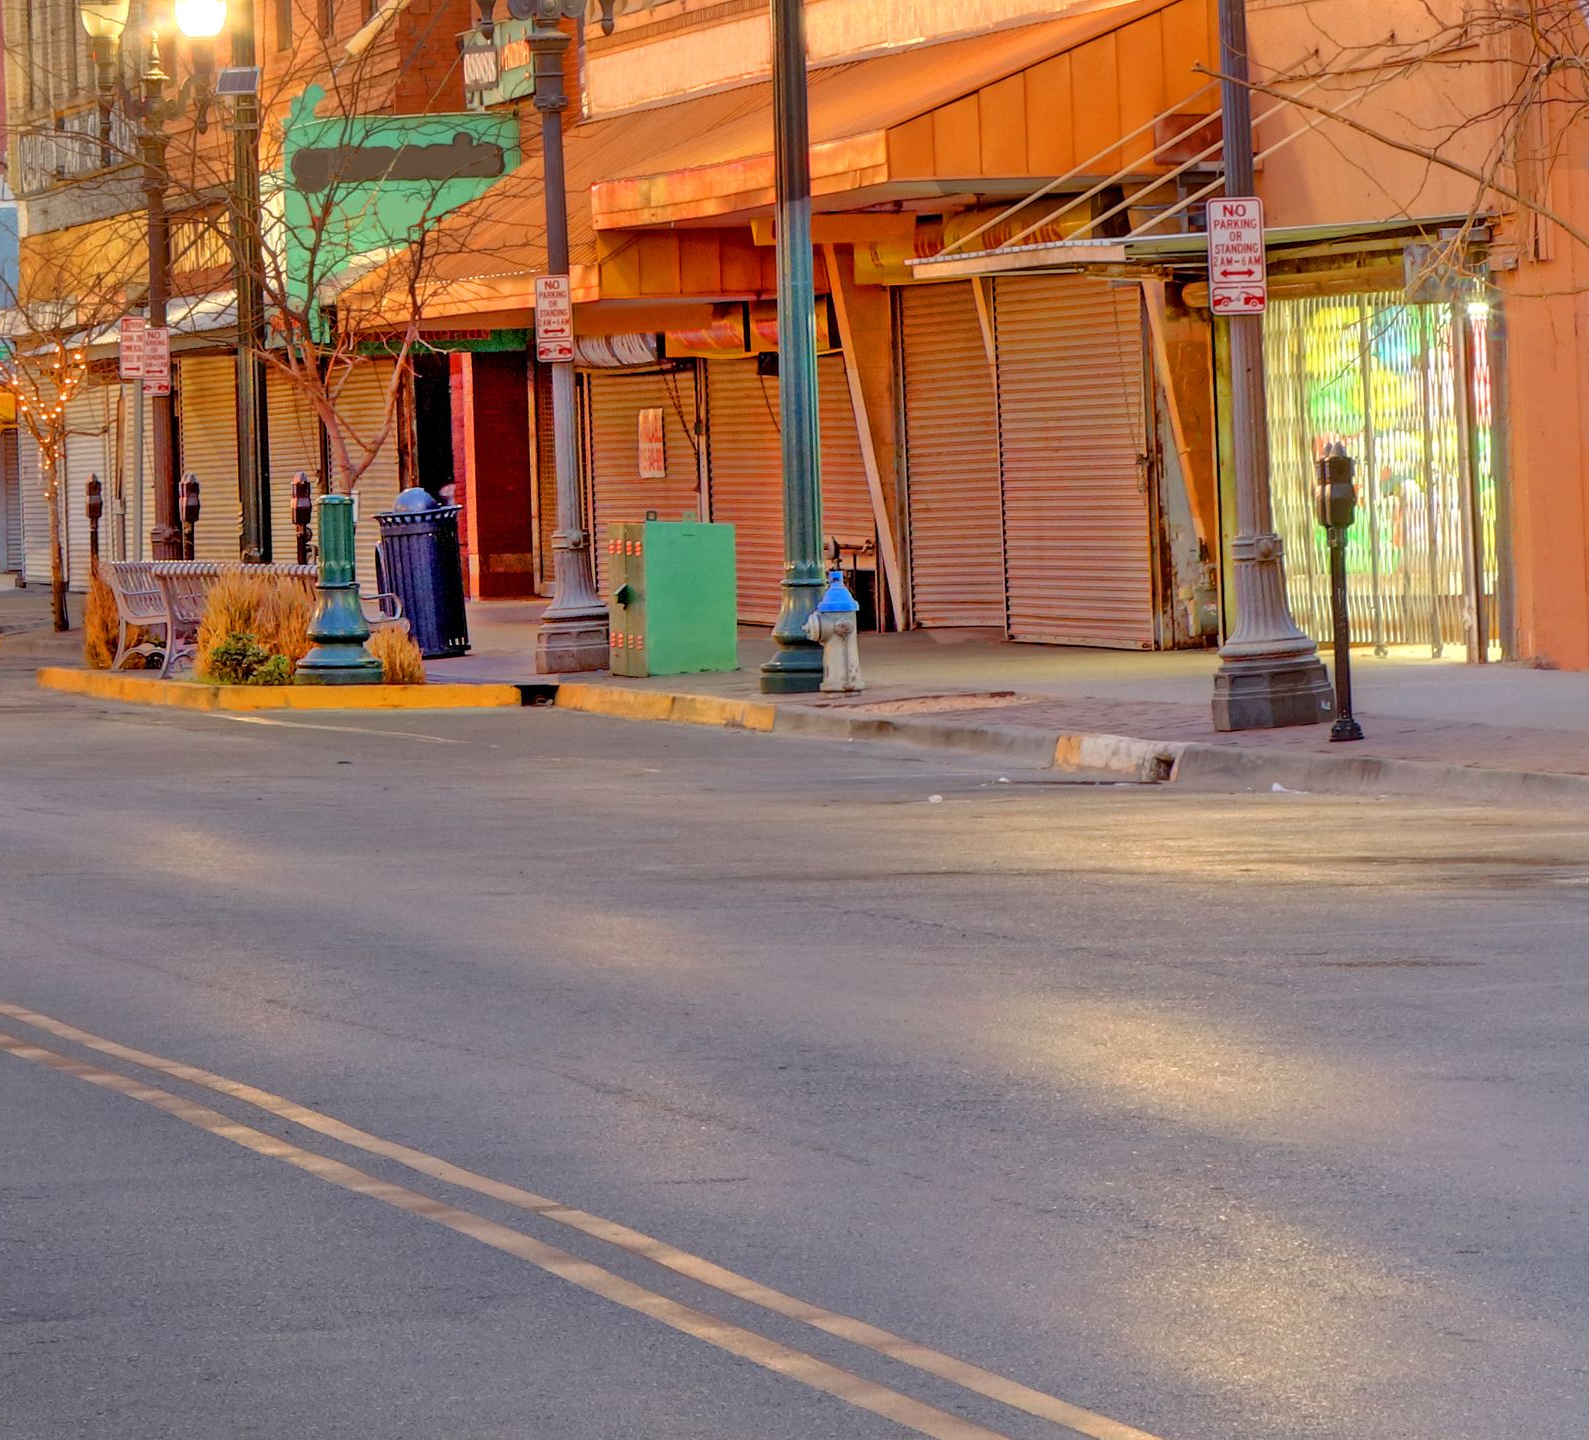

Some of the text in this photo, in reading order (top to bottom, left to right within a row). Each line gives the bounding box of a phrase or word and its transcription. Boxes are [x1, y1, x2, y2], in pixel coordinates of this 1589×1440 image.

[1222, 204, 1246, 217] NO
[1213, 219, 1257, 230] PARKING
[1229, 231, 1242, 241] OR
[1214, 244, 1259, 254] STANDING
[544, 280, 560, 289] NO
[538, 291, 567, 299] PARKING
[539, 309, 568, 317] STANDING
[147, 331, 160, 339] NO
